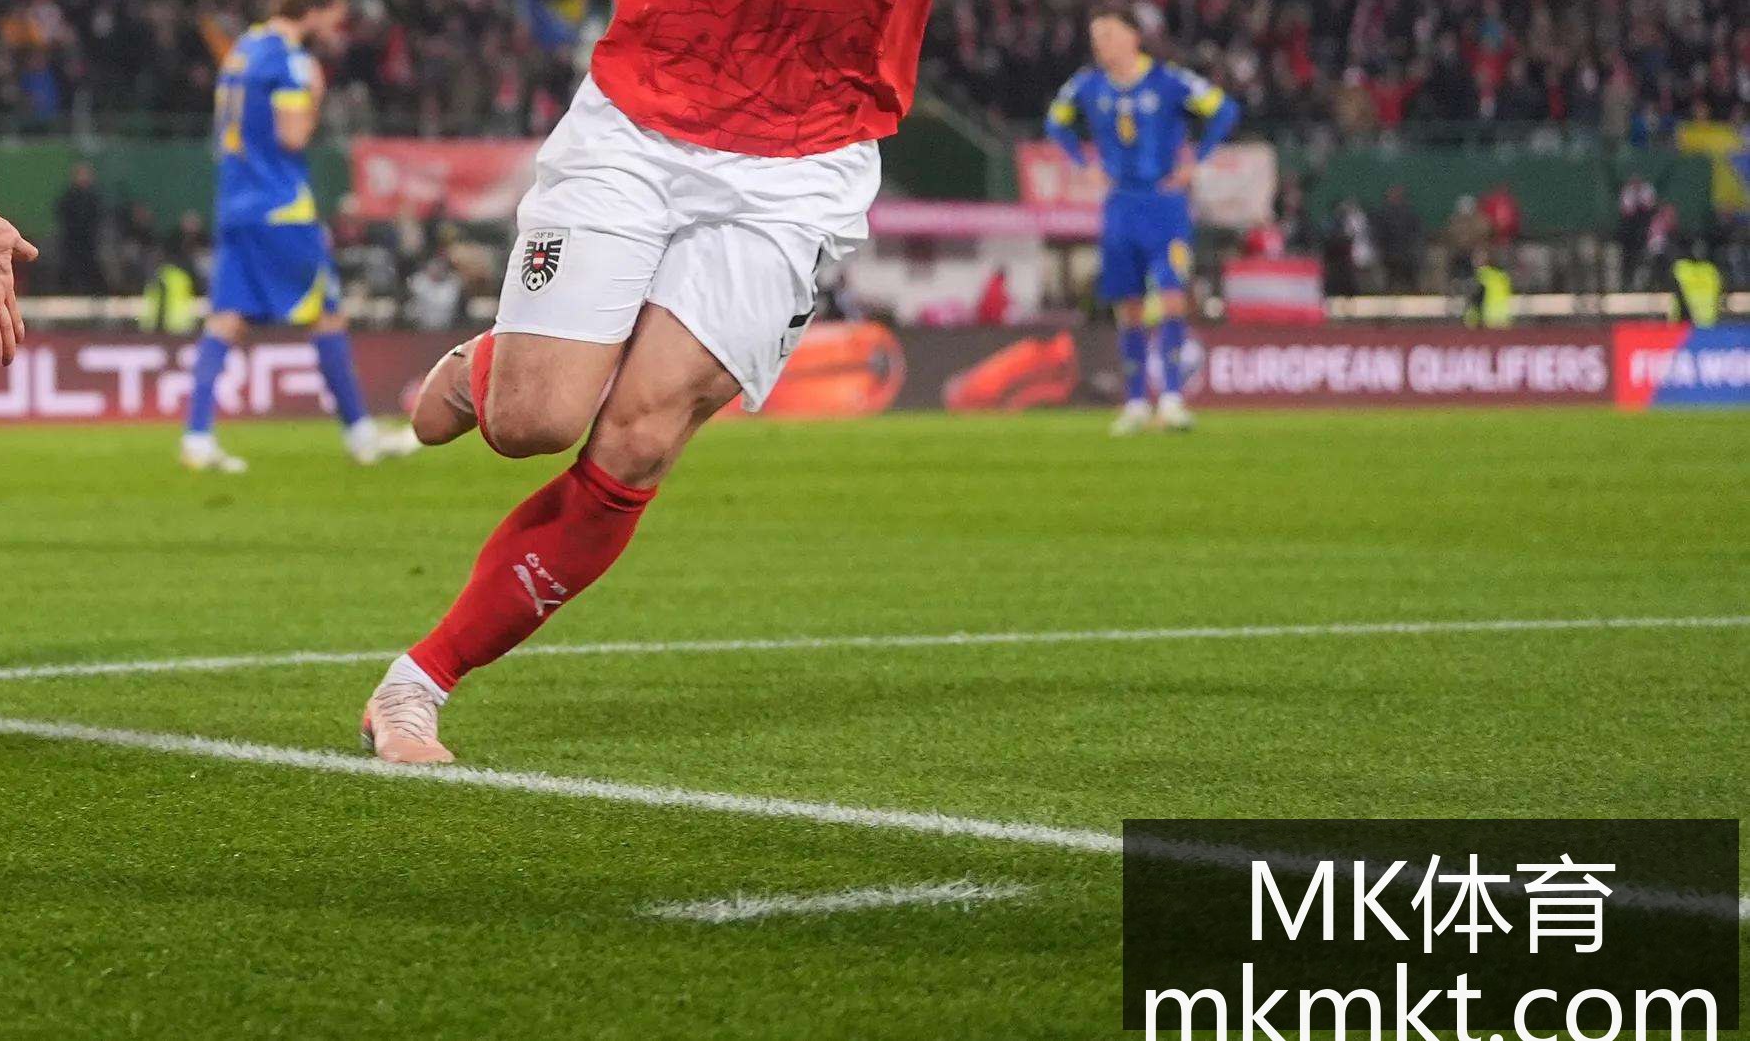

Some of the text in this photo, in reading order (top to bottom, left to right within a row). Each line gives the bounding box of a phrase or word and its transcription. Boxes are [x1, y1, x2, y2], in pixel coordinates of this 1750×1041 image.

[1210, 345, 1610, 393] EUROPEAN QUALIFIERS
[1629, 348, 1697, 387] FIFA
